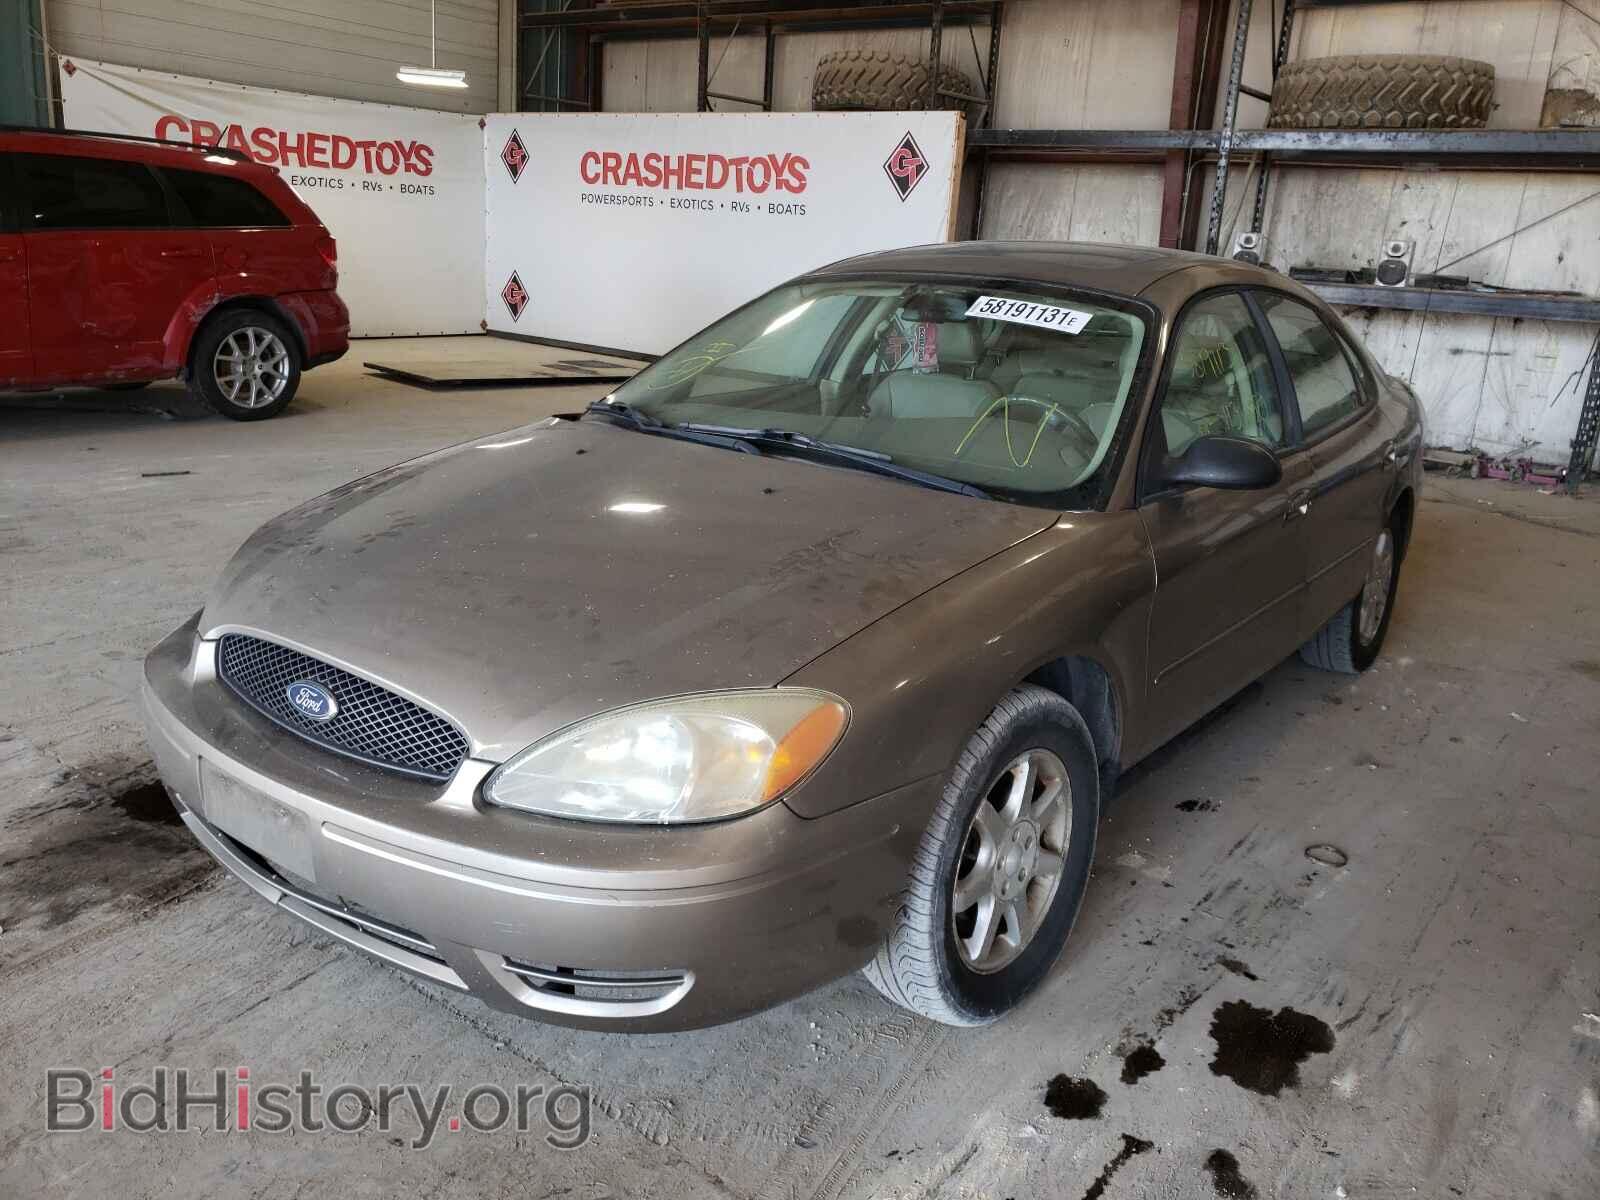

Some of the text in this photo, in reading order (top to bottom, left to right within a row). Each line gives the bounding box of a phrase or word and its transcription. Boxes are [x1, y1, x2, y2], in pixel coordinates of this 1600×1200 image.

[154, 115, 434, 177] CRASHEDTOYS
[291, 175, 435, 195] EXOTICS RVs BOATS
[580, 151, 811, 194] CRASHEDTOYS
[581, 193, 806, 215] POWERSPORTS EXOTICS RVs BOATS
[295, 687, 324, 713] Ford
